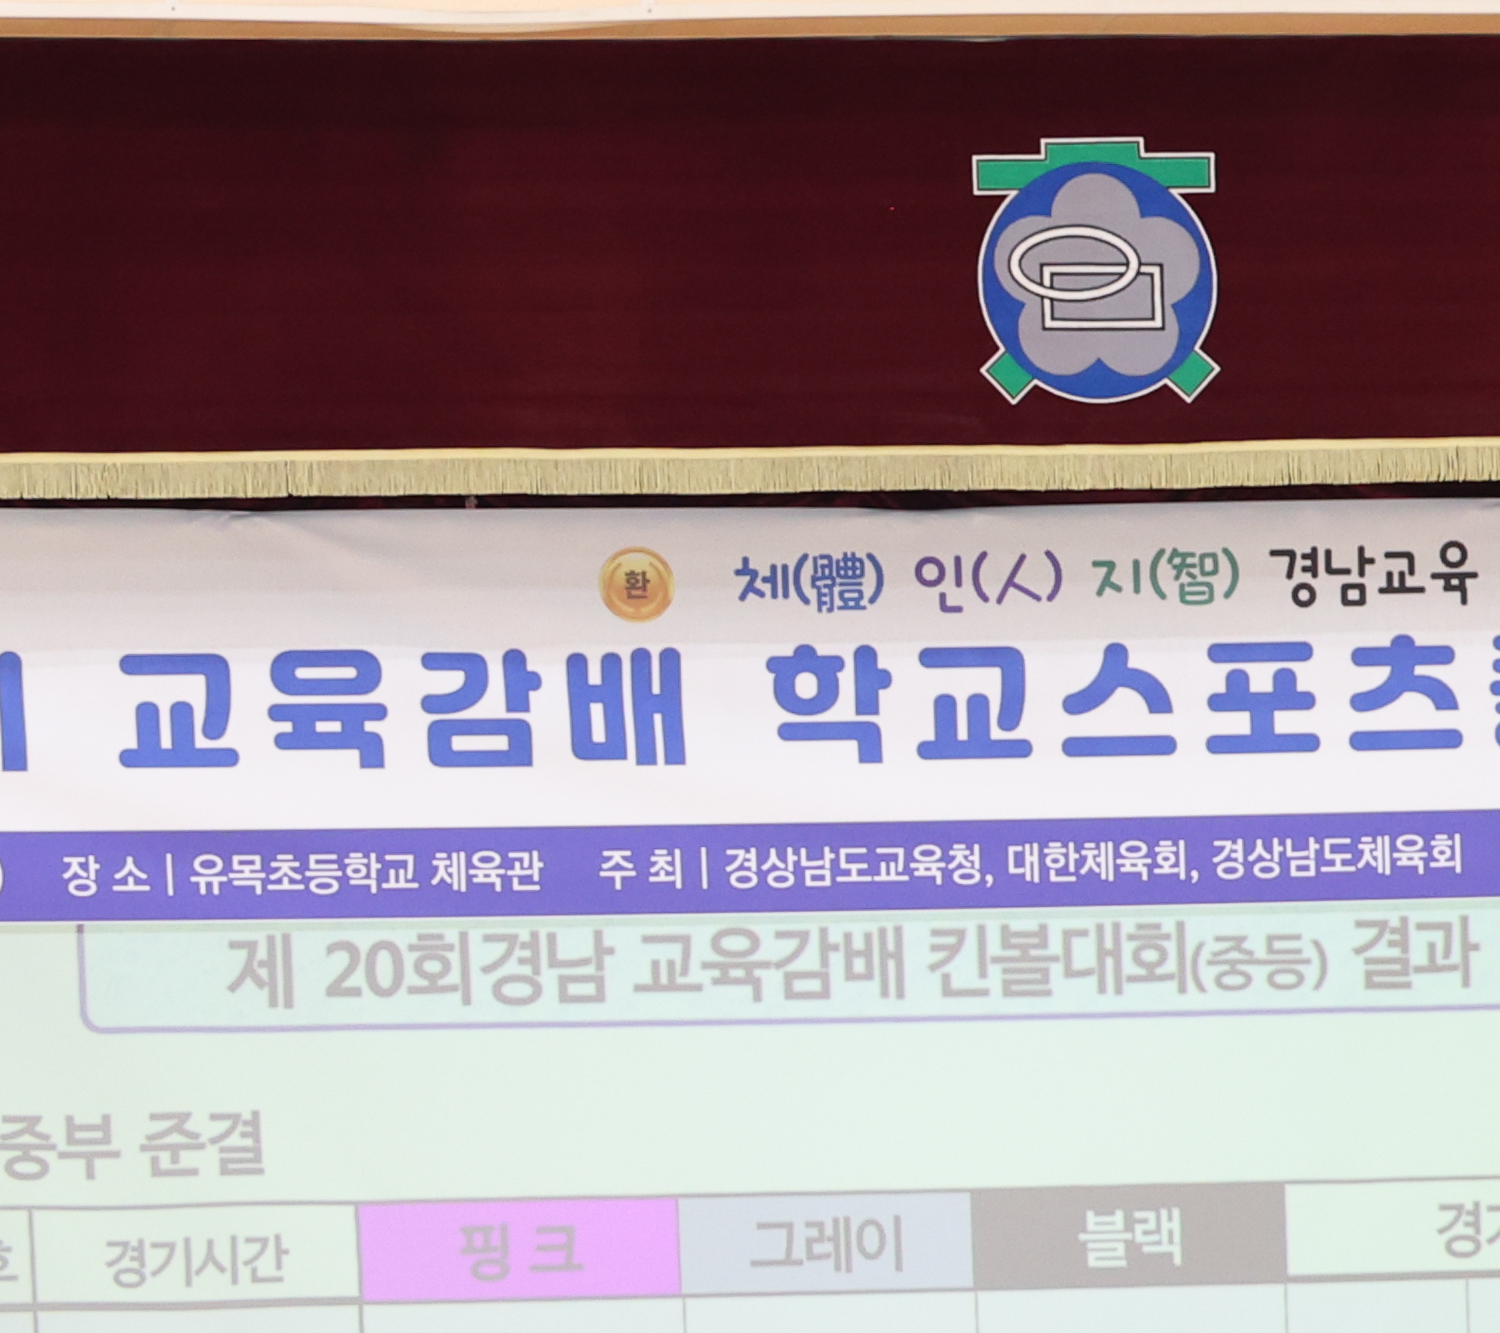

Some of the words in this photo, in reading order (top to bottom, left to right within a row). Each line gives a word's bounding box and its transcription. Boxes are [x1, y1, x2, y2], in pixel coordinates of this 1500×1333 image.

[624, 569, 650, 600] 환
[734, 550, 884, 613] 체(體)
[915, 550, 1062, 613] 인(人)
[1092, 547, 1239, 606] 지(智)
[1269, 541, 1478, 607] 경남교육
[119, 647, 686, 768] 교육감배
[190, 853, 419, 895] 유목초등학교
[431, 851, 544, 892] 체육관
[725, 844, 993, 888] 경상남도교육청,
[1008, 840, 1198, 883] 대한체육회,
[1213, 834, 1461, 879] 경상남도체육회
[227, 934, 294, 1009] 제
[631, 923, 906, 1002] 교육감배
[928, 921, 1328, 997] 킨볼대회(중등)
[1352, 915, 1480, 990] 결과
[140, 1110, 264, 1177] 준결
[105, 1234, 290, 1288] 경기시간
[750, 1215, 903, 1273] 그레이
[1078, 1208, 1181, 1267] 블랙
